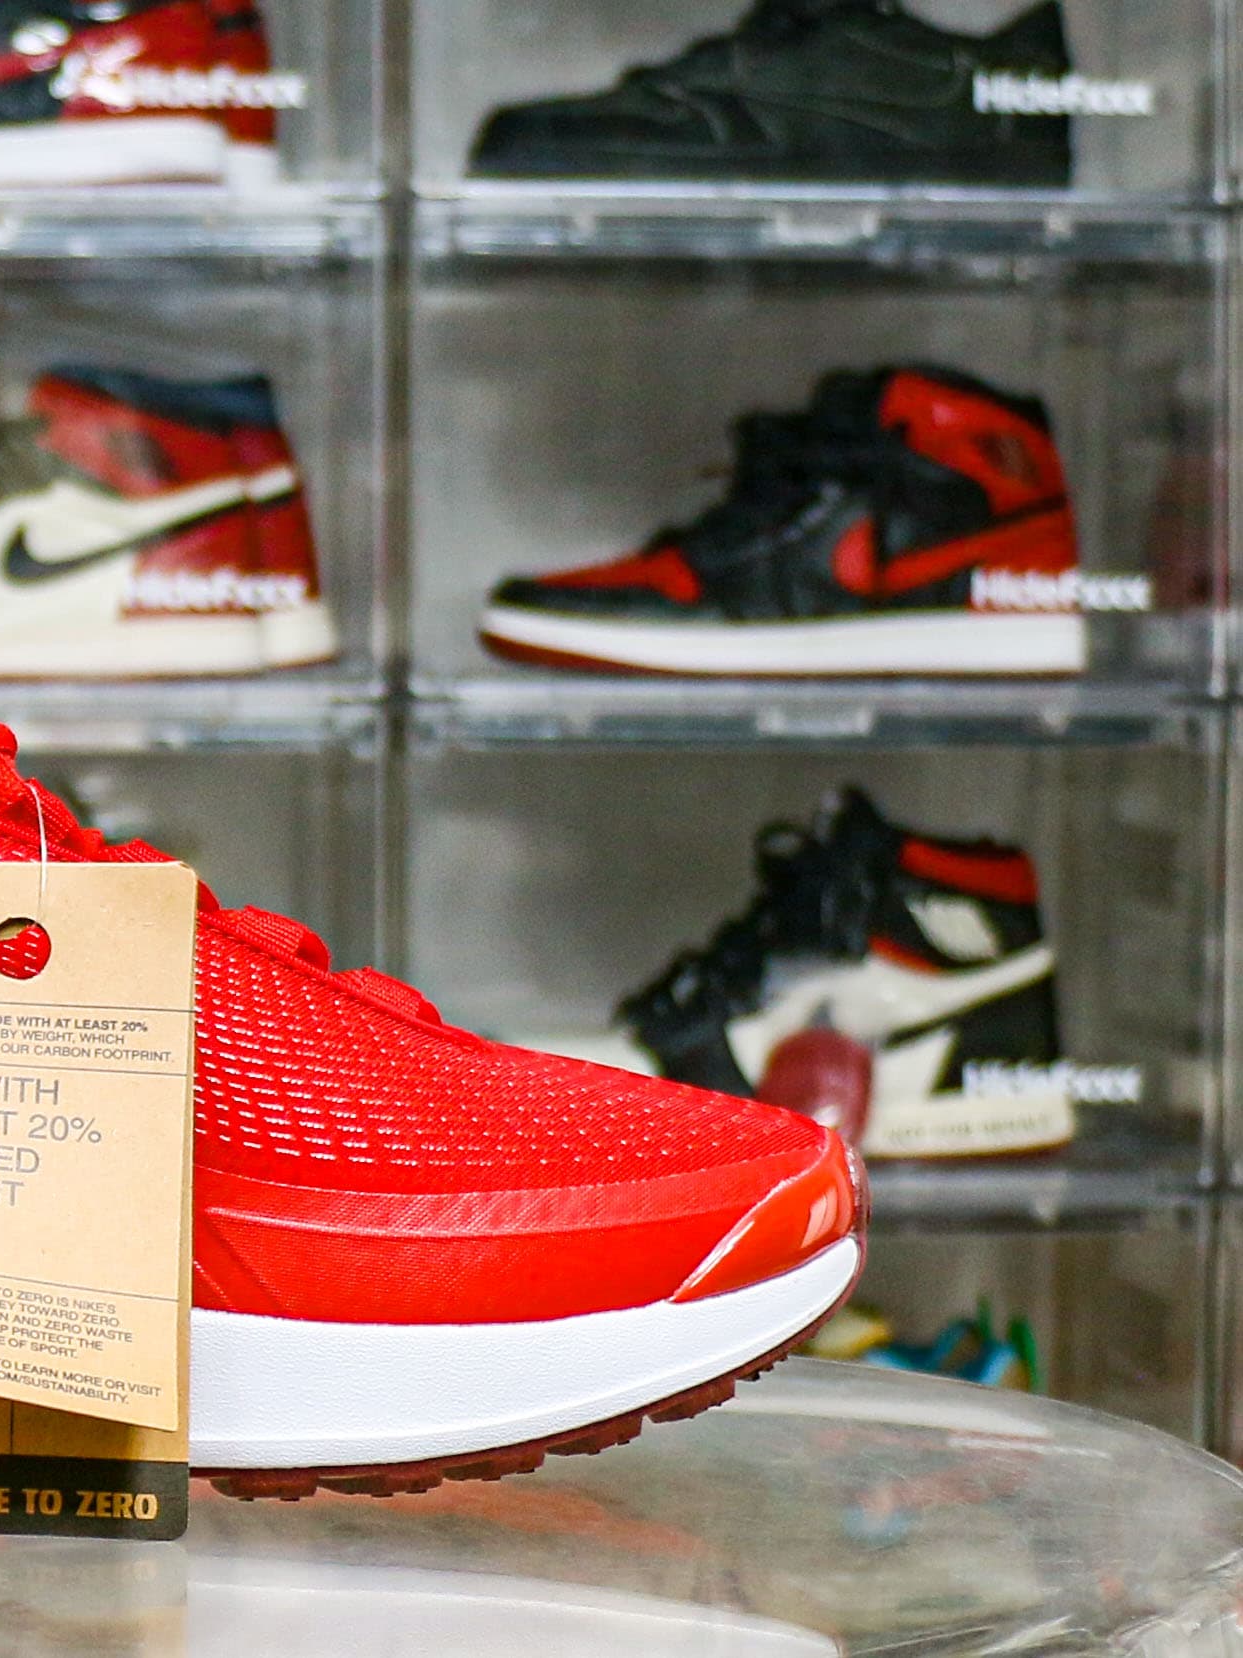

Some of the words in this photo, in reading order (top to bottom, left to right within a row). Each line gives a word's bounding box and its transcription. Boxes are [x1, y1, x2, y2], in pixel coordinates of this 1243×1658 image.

[17, 1016, 50, 1027] WITH
[54, 1018, 70, 1029] AT
[74, 1019, 118, 1030] LEAST
[121, 1021, 148, 1032] 20%
[0, 1029, 17, 1039] BY
[22, 1030, 75, 1043] WEIGHT,
[80, 1033, 125, 1044] WHICH
[0, 1044, 29, 1054] OUR
[34, 1045, 91, 1058] CARBON
[95, 1049, 174, 1062] FOOTPRINT.
[28, 1114, 101, 1144] 20%
[16, 1290, 53, 1304] ZERO
[57, 1297, 69, 1307] IS
[73, 1300, 116, 1314] NIKE'S
[19, 1303, 78, 1321] TOWARD
[82, 1312, 120, 1328] ZERO
[12, 1315, 41, 1327] AND
[44, 1320, 82, 1334] ZERO
[86, 1327, 133, 1343] WASTE
[12, 1327, 74, 1345] PROTECT
[76, 1337, 104, 1351] THE
[8, 1338, 28, 1349] OF
[30, 1342, 77, 1358] SPORT.
[14, 1362, 58, 1378] LEARN
[62, 1371, 103, 1387] MORE
[105, 1379, 125, 1391] OR
[128, 1383, 162, 1397] VISIT
[22, 1489, 61, 1516] TO
[75, 1491, 158, 1520] ZERO
